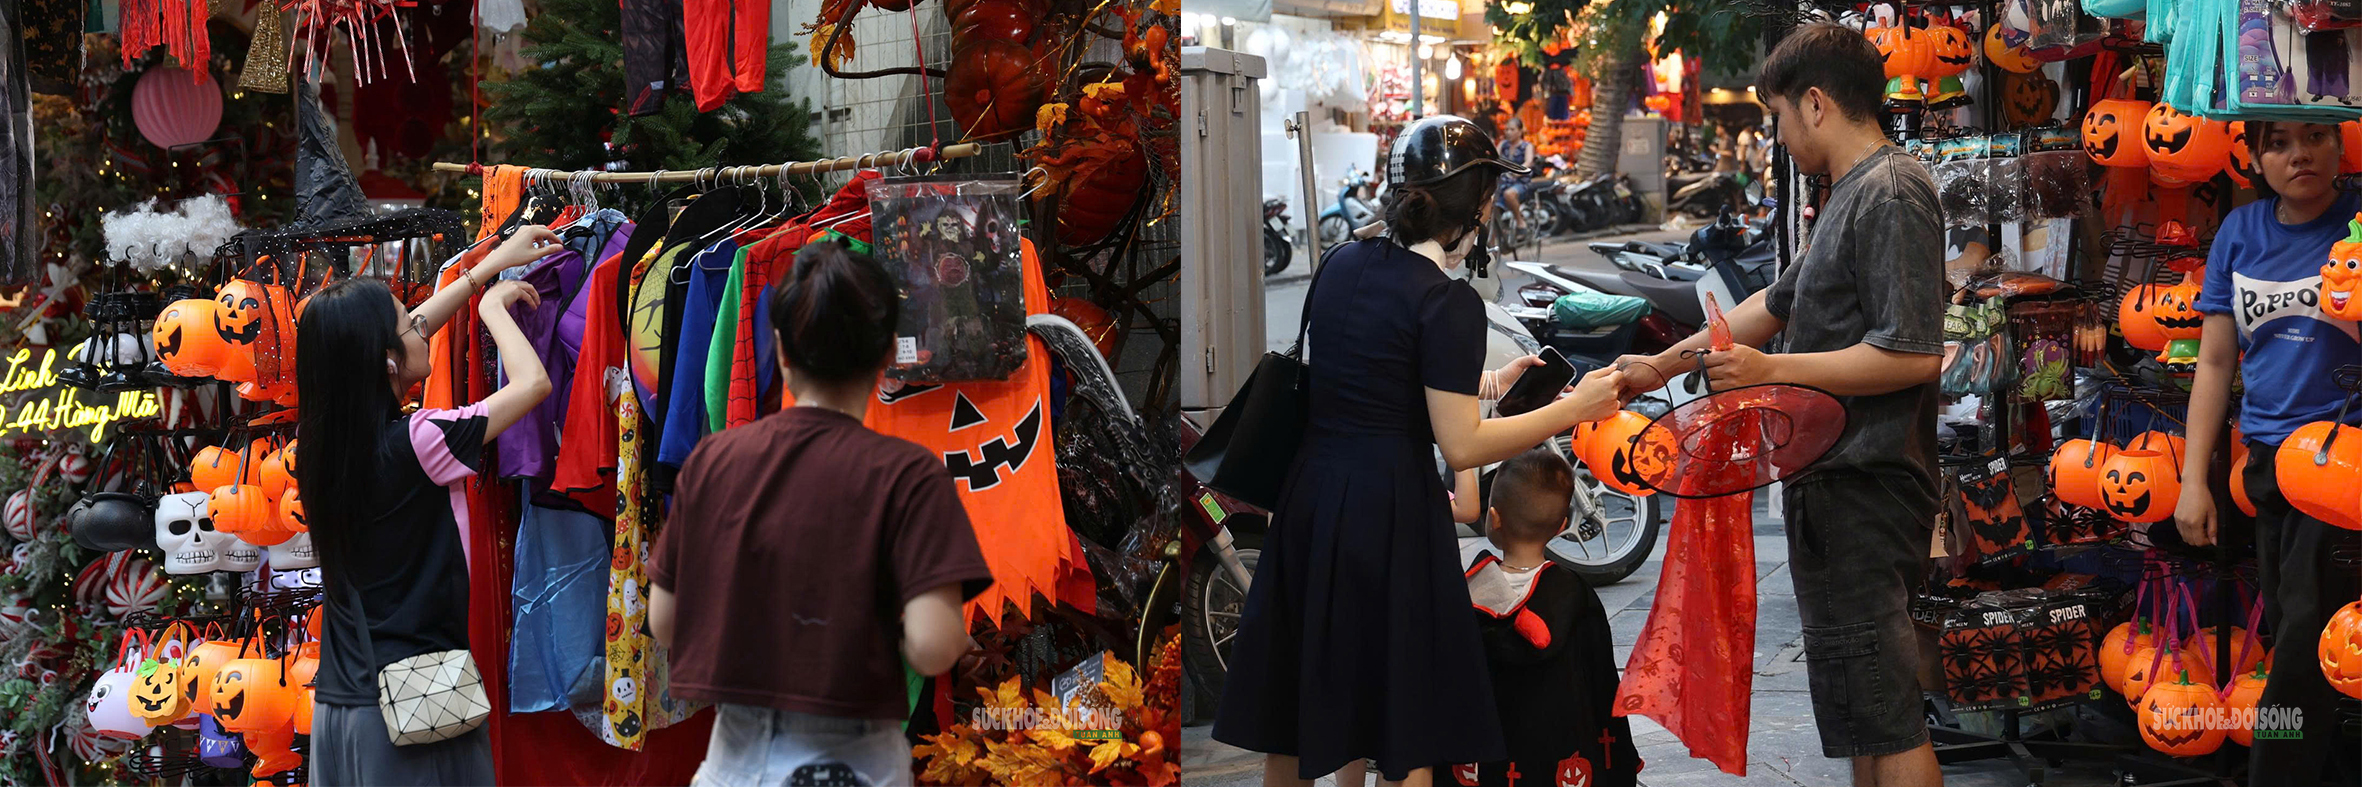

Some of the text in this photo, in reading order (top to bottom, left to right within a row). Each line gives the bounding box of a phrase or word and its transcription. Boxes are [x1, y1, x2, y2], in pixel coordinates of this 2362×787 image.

[2240, 281, 2322, 326] POPPO
[47, 387, 112, 443] Hàng
[1987, 457, 2007, 476] SPIDER
[1982, 610, 2016, 627] SPIDER
[2049, 603, 2087, 624] SPIDER
